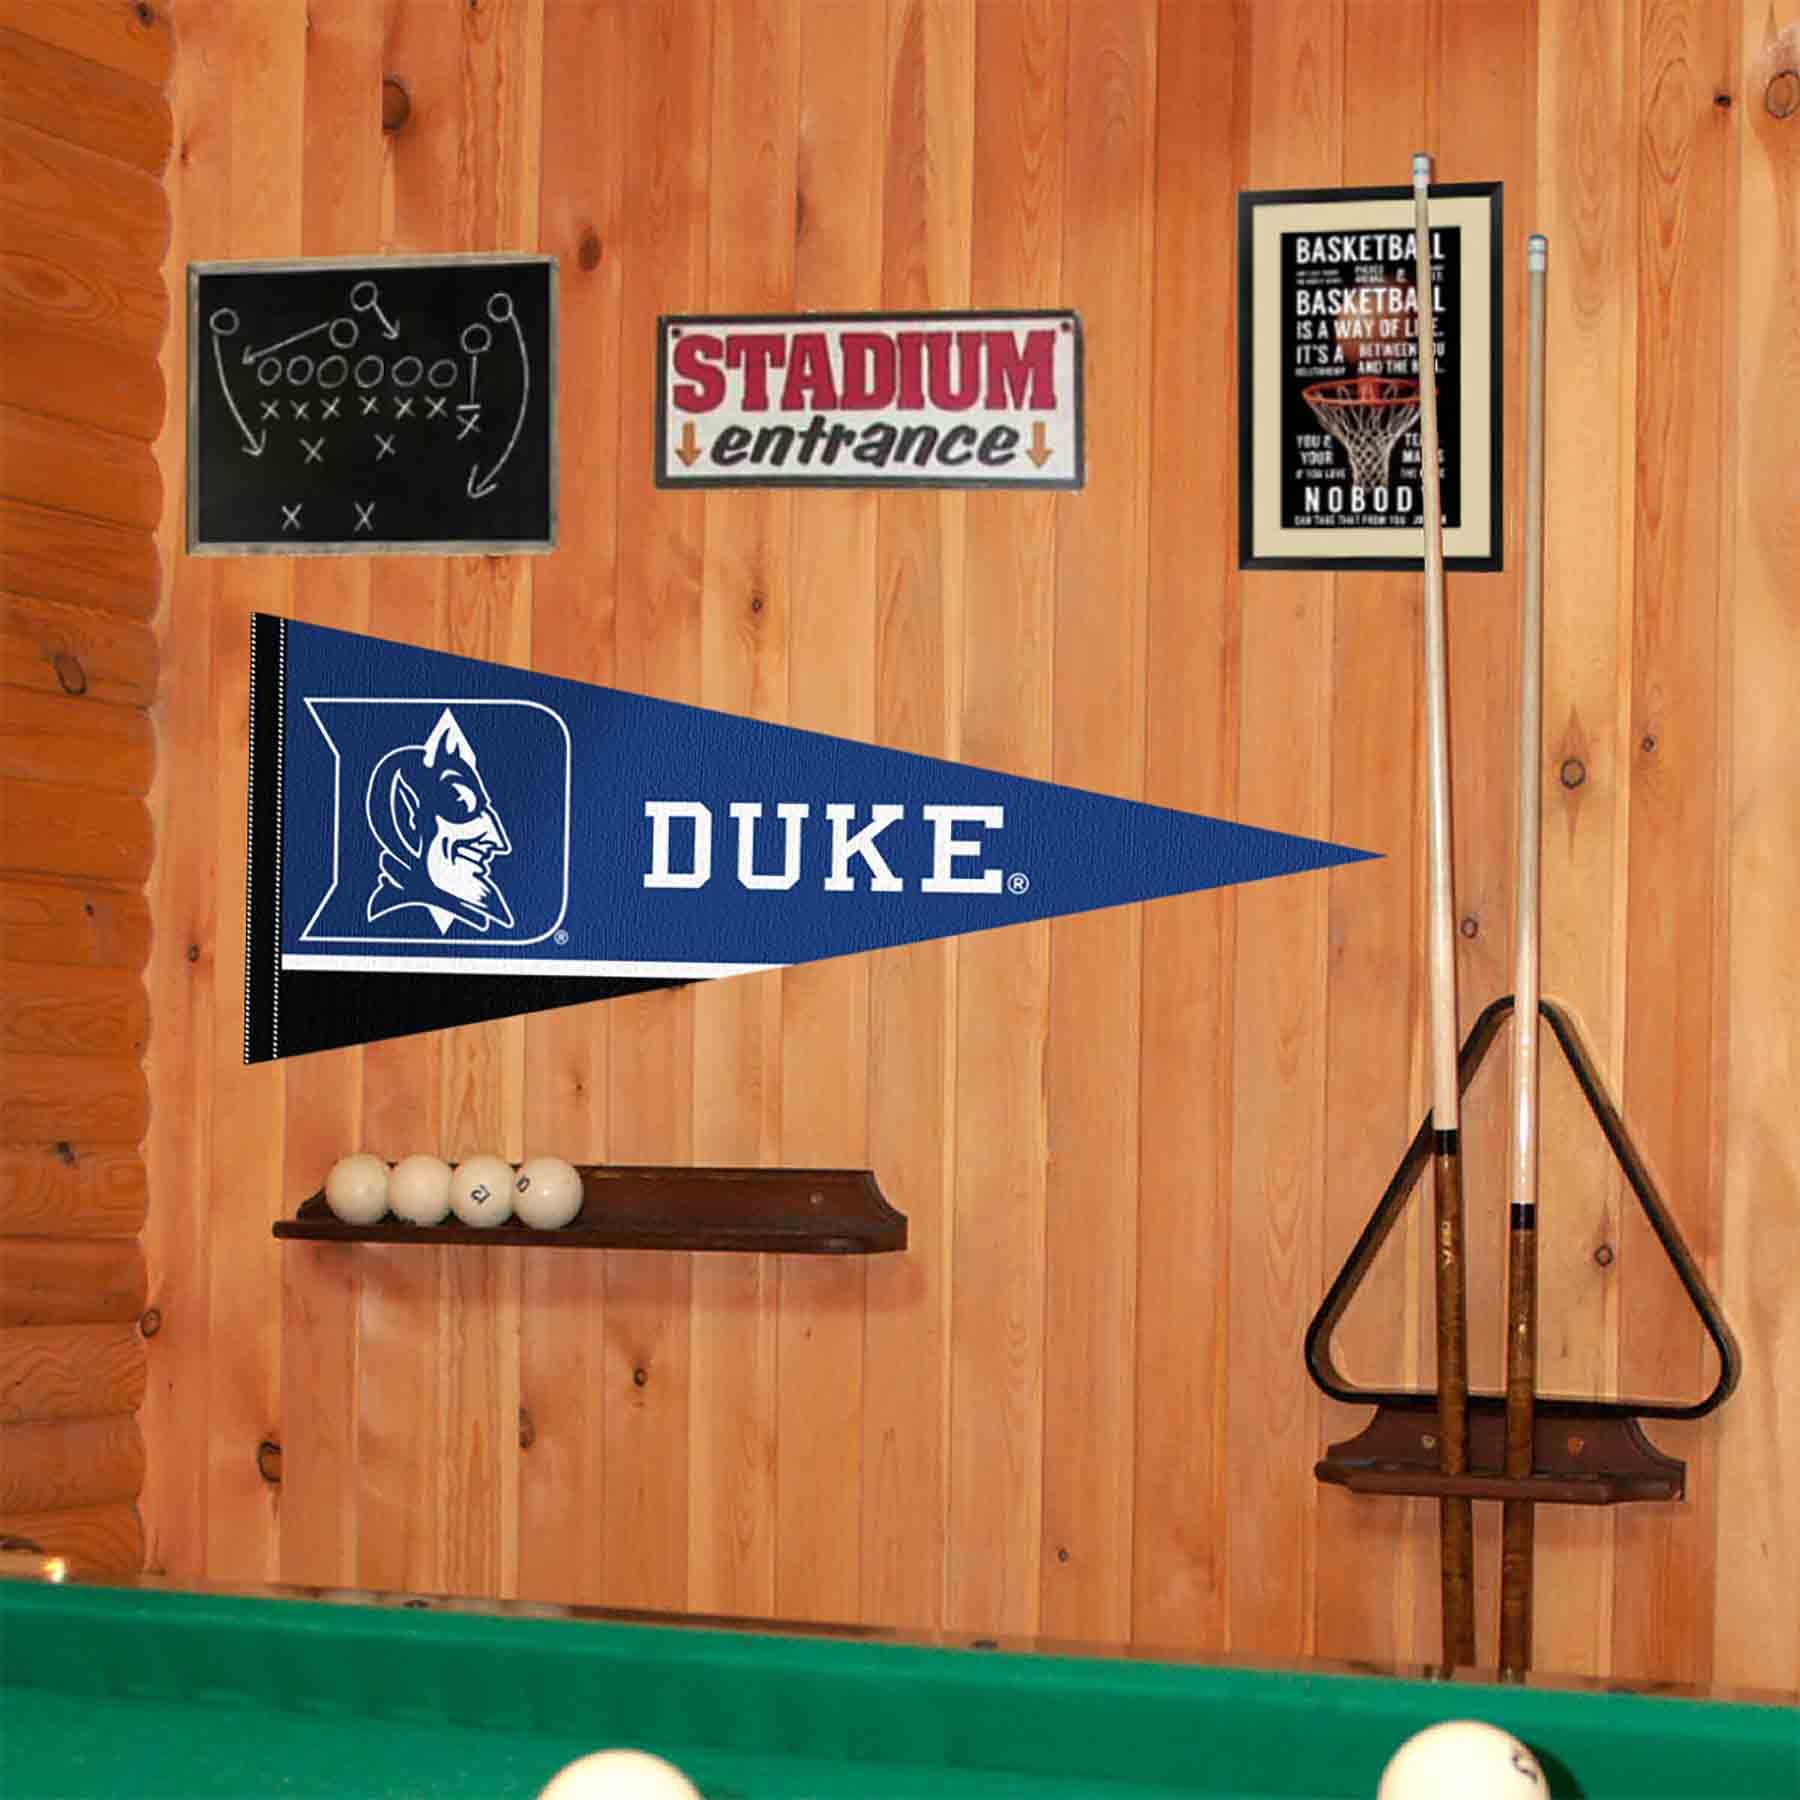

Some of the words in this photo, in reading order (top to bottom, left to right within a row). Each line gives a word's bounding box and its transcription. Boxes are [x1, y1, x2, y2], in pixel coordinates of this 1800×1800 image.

[1296, 232, 1445, 264] BASKETBAL
[1296, 285, 1446, 317] BASKETBAL
[1296, 320, 1312, 340] IS
[1317, 320, 1328, 339] A
[1334, 319, 1376, 339] WAY
[1379, 318, 1400, 338] OF
[1404, 317, 1445, 337] LIE.
[1296, 344, 1328, 365] IT'S
[1333, 344, 1344, 364] A
[1358, 360, 1383, 376] AND
[1386, 359, 1408, 375] THE
[672, 330, 1058, 413] STADIUM
[710, 415, 1020, 467] entrance
[1304, 485, 1423, 514] NOBOD
[643, 800, 1005, 895] DUKE
